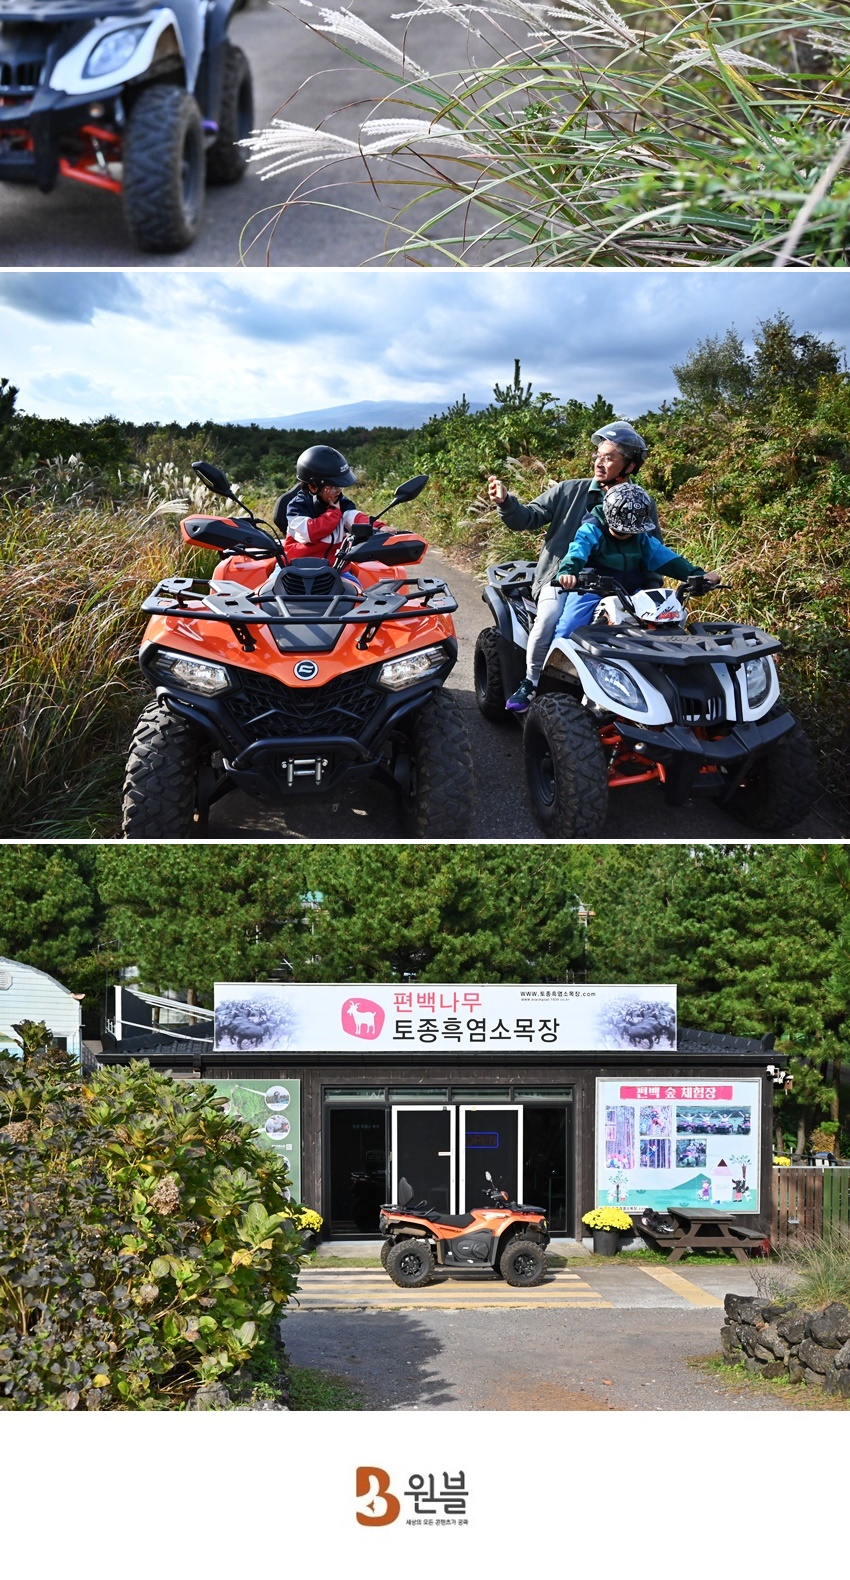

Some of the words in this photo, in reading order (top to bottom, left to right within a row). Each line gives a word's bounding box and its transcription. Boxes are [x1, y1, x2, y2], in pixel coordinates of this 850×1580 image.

[393, 992, 482, 1013] 편백나무
[392, 1017, 560, 1043] 토종흑염소목장
[637, 1086, 661, 1099] 편백
[664, 1086, 677, 1099] 숲
[681, 1086, 717, 1099] 체험장
